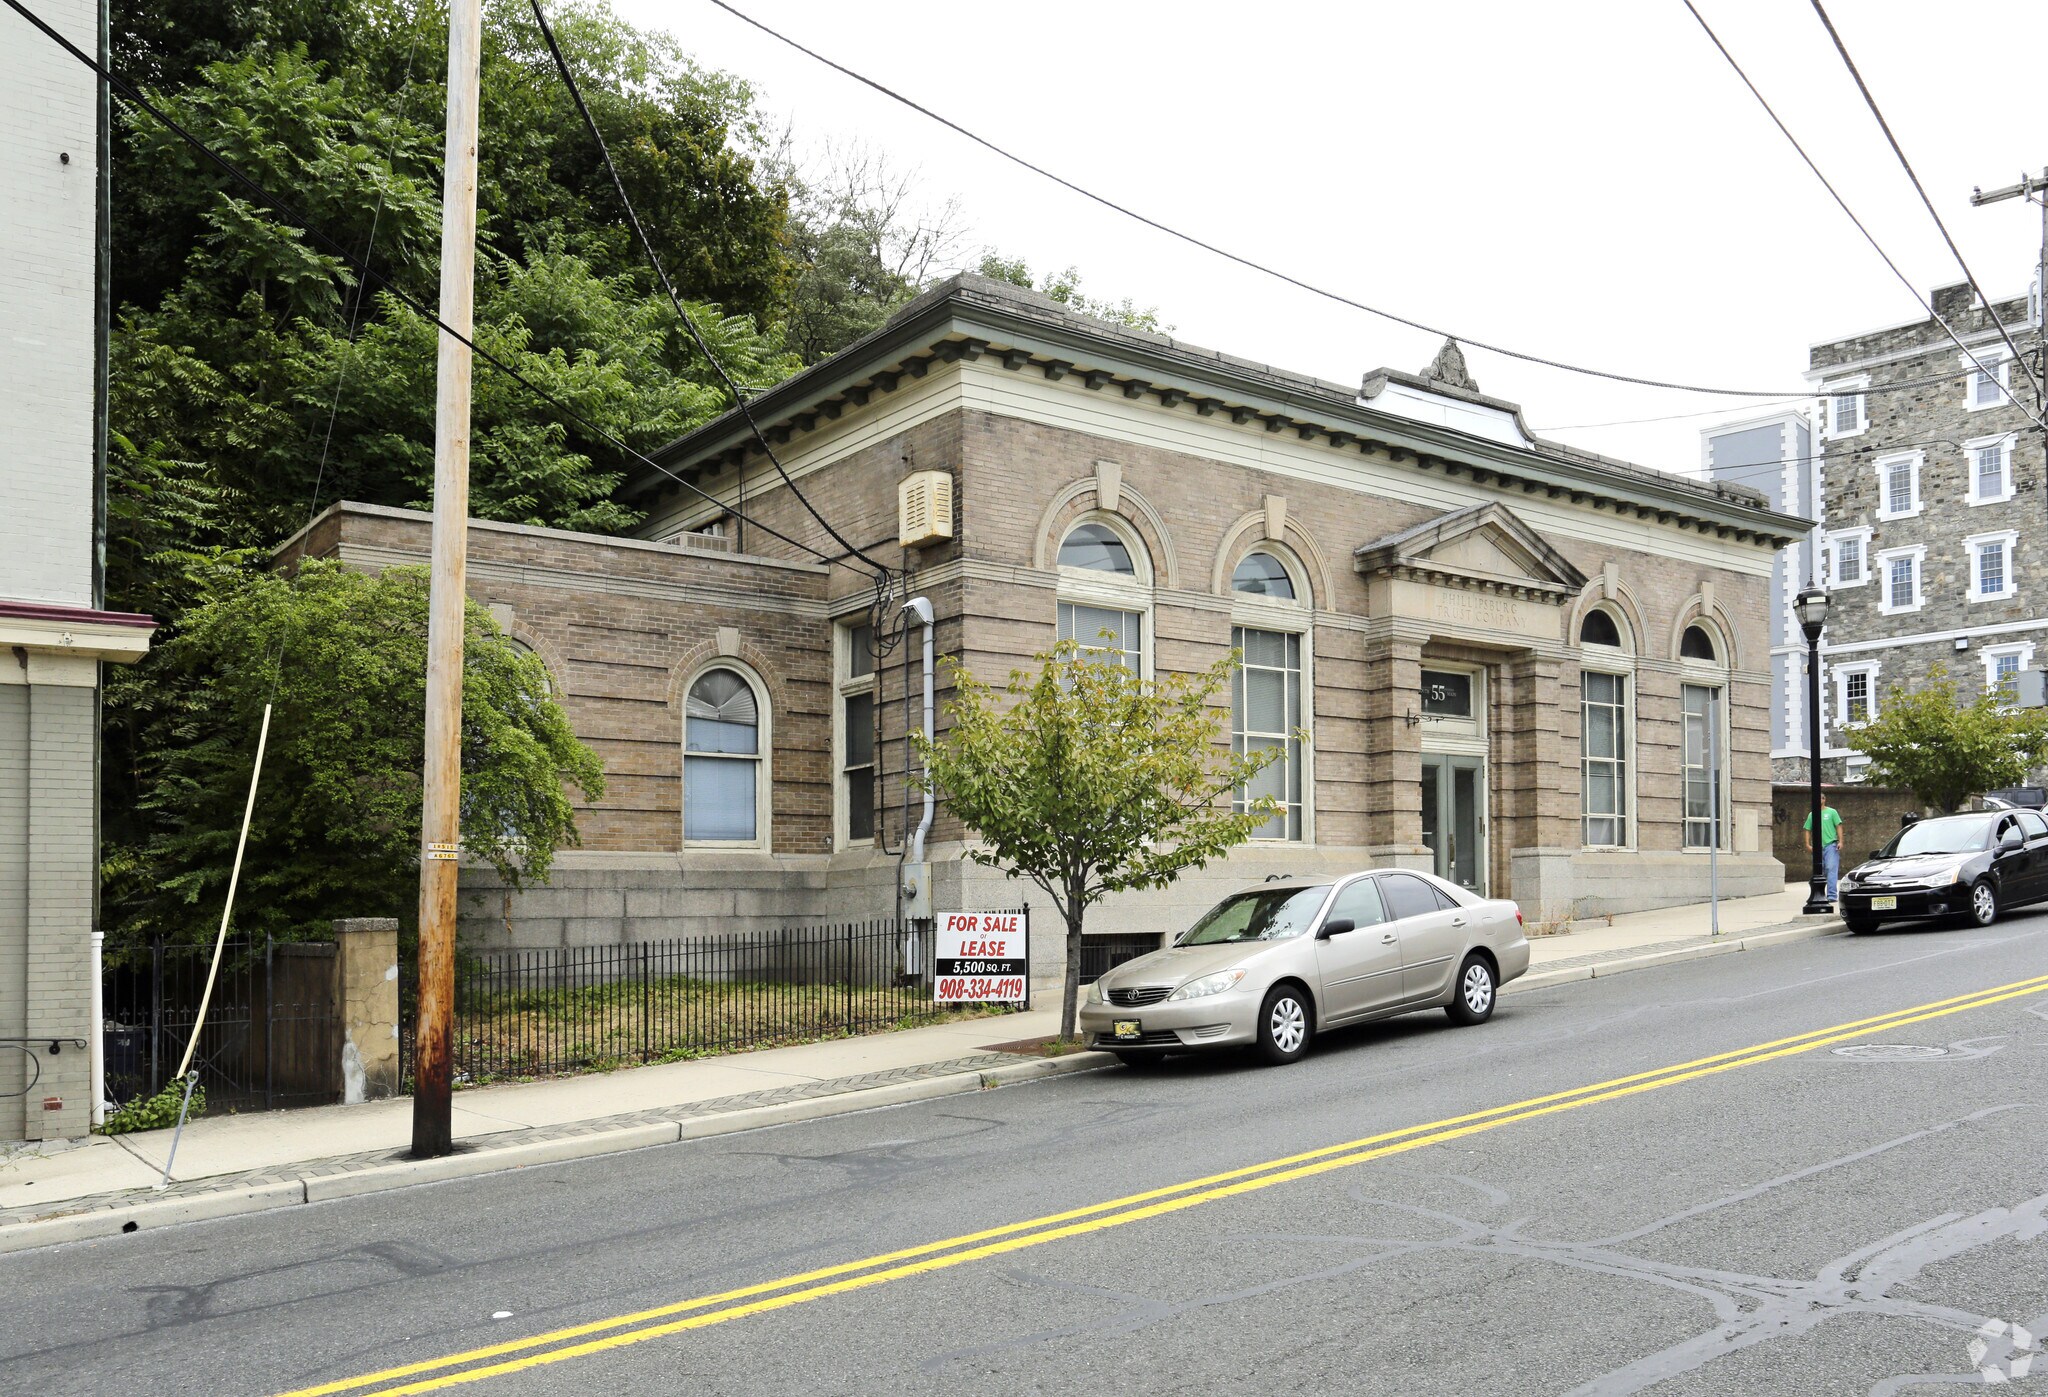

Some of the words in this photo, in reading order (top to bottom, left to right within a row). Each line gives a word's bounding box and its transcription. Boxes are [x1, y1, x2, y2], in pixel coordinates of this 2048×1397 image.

[1442, 592, 1518, 614] PHILLIPSBURG
[1436, 604, 1472, 621] TRUST
[1475, 611, 1528, 629] COMPANY
[1431, 684, 1446, 701] 55
[947, 915, 978, 932] FOR
[982, 916, 1018, 932] SALE
[959, 940, 1006, 957] LEASE
[953, 961, 985, 975] 5,500
[986, 963, 1000, 972] SQ.
[1001, 964, 1012, 972] FT.
[938, 978, 1023, 999] 908-334-4119
